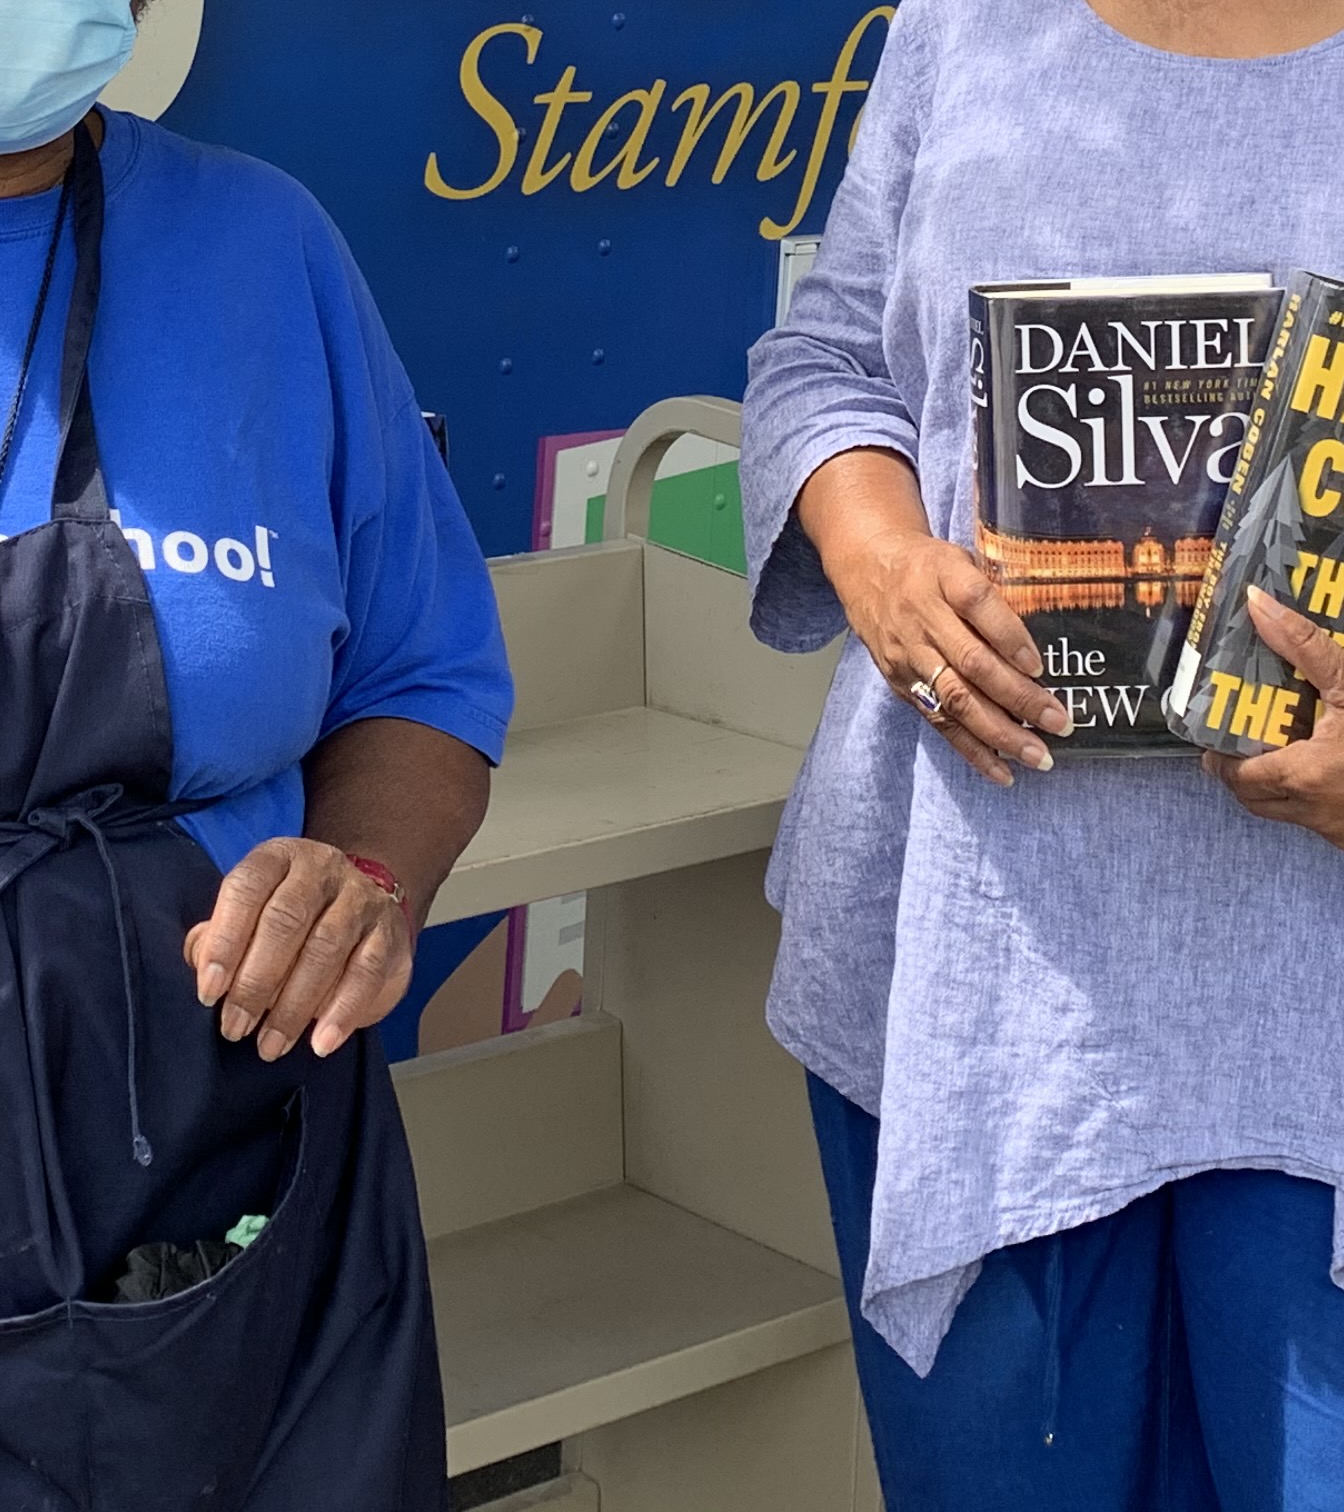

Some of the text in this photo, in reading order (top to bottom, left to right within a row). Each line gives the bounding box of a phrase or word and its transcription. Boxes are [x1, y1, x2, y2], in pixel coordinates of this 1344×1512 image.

[424, 5, 895, 241] Stamf
[1014, 318, 1266, 375] DANIEL
[1143, 391, 1257, 405] BESTSELLING AUT
[1165, 380, 1191, 391] NEW
[1198, 379, 1230, 390] YORK
[1237, 377, 1260, 389] TIM
[1230, 293, 1302, 496] HARLAN COBEN
[1016, 374, 1249, 490] Silva
[1044, 637, 1106, 678] the
[1204, 670, 1302, 747] THE
